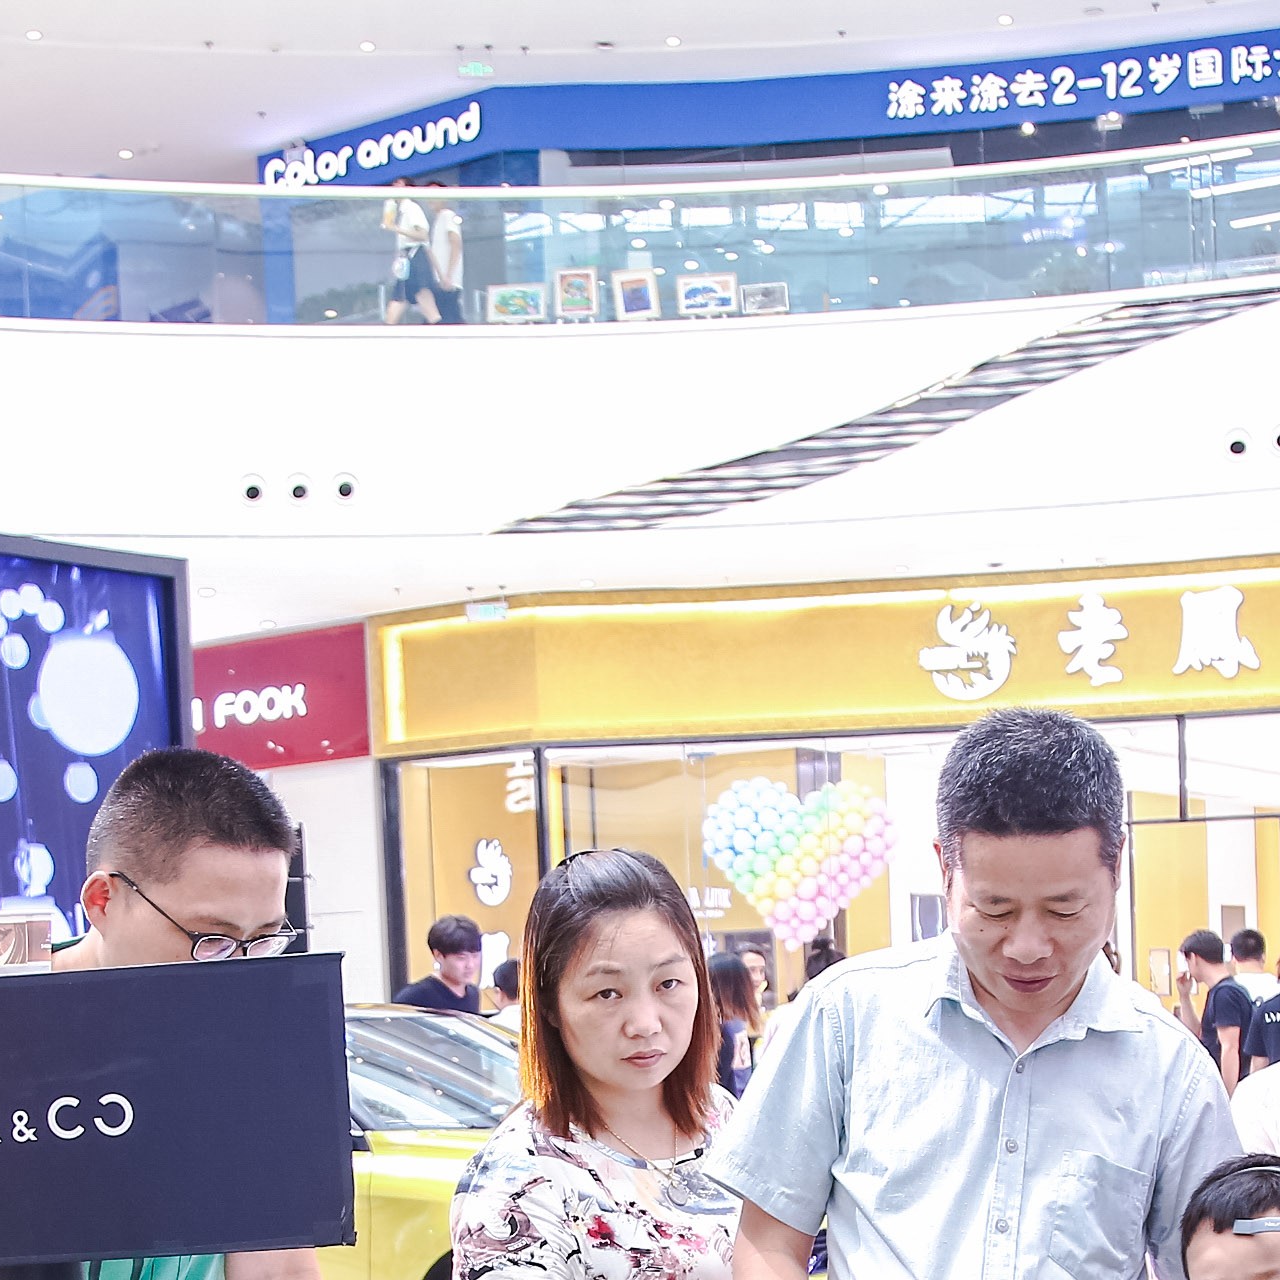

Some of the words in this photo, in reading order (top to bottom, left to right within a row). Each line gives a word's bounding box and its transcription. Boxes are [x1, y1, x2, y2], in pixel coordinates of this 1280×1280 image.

[263, 148, 354, 189] Color
[356, 100, 482, 170] around
[214, 682, 308, 729] FOOK
